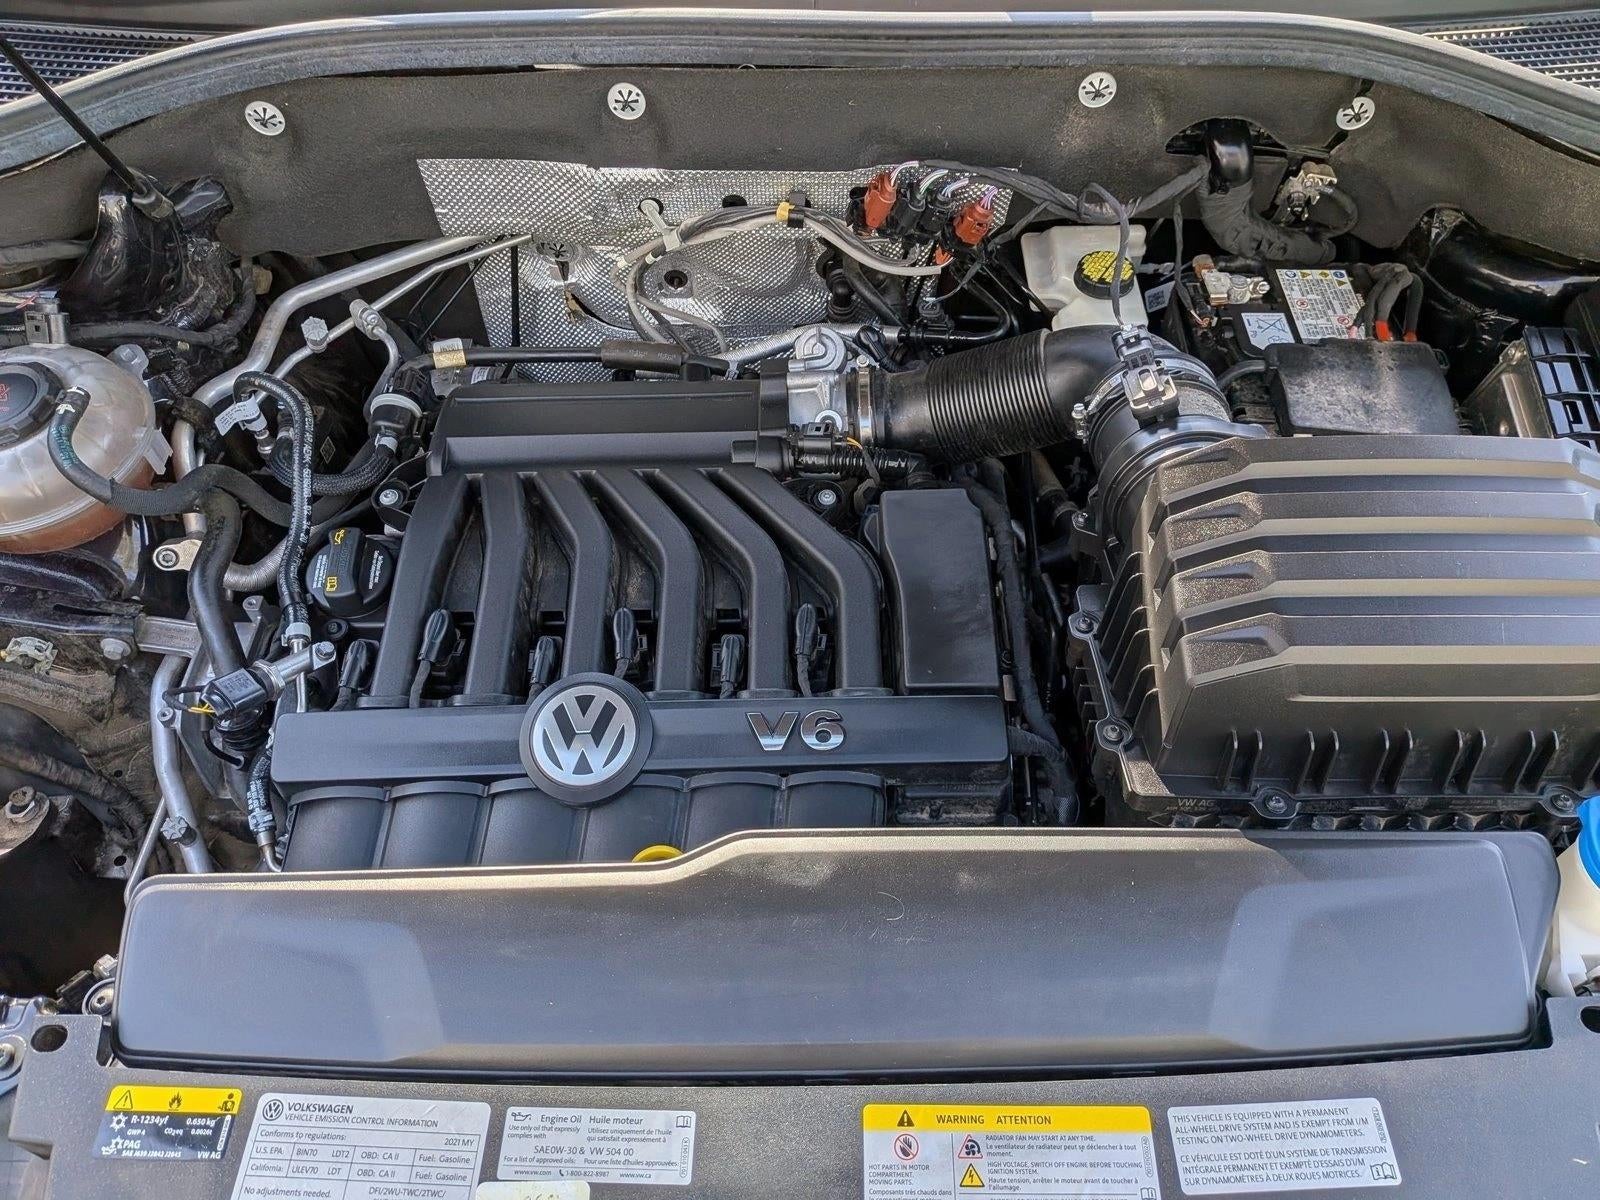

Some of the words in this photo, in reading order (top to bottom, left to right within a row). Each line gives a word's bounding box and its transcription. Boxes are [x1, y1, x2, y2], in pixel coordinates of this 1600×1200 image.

[745, 709, 846, 751] V6
[533, 685, 636, 786] VW
[1177, 798, 1197, 807] VW
[1198, 799, 1216, 807] AG
[288, 1102, 354, 1114] VOLKSWAGEN
[130, 1115, 169, 1125] R-1234yf
[541, 1114, 568, 1125] Engine
[570, 1115, 581, 1123] Oil
[589, 1116, 610, 1124] Huile
[612, 1116, 643, 1125] moteur
[936, 1114, 984, 1124] WARNING
[996, 1115, 1052, 1125] ATTENTION
[1173, 1115, 1190, 1123] THIS
[1191, 1114, 1223, 1122] VEHICLE
[1234, 1112, 1271, 1121] EQUIPPED
[1272, 1110, 1294, 1118] WITH
[1296, 1110, 1301, 1118] A
[1302, 1108, 1348, 1117] PERMANENT
[206, 1118, 216, 1127] kg
[315, 1115, 350, 1123] EMISSION
[351, 1116, 384, 1125] CONTROL
[386, 1118, 438, 1127] INFORMATION
[1175, 1125, 1218, 1134] ALL-WHEEL
[1219, 1124, 1241, 1132] DRIVE
[1243, 1122, 1272, 1131] SYSTEM
[1274, 1121, 1291, 1129] AND
[1301, 1119, 1331, 1128] EXEMPT
[1332, 1118, 1354, 1126] FROM
[1355, 1117, 1369, 1125] I/M
[260, 1129, 294, 1138] Conforms
[305, 1132, 346, 1141] regulations:
[554, 1126, 580, 1134] expressly
[1177, 1136, 1208, 1145] TESTING
[1224, 1133, 1273, 1142] TWO-WHEEL
[1274, 1132, 1298, 1140] DRIVE
[1299, 1128, 1365, 1139] DYNAMOMETERS.
[123, 1140, 141, 1149] PAG
[255, 1146, 268, 1154] U.S.
[296, 1148, 317, 1157] BIN70
[332, 1150, 350, 1158] LDT2
[578, 1146, 585, 1154] &
[590, 1147, 604, 1155] VW
[606, 1148, 621, 1156] 504
[623, 1148, 634, 1156] 00
[1180, 1155, 1190, 1163] CE
[1190, 1153, 1228, 1162] VÉHICULE
[1230, 1153, 1242, 1161] EST
[1243, 1150, 1263, 1160] DOTÉ
[1265, 1150, 1285, 1159] D'UN
[1287, 1148, 1319, 1158] SYSTÈME
[1320, 1148, 1330, 1156] DE
[1331, 1146, 1387, 1156] TRANSMISSION
[361, 1151, 379, 1159] OBD:
[382, 1152, 392, 1160] CA
[419, 1154, 436, 1162] Fuel:
[440, 1154, 470, 1163] Gasoline
[251, 1163, 283, 1172] California:
[291, 1165, 318, 1174] ULEV70
[327, 1166, 341, 1174] LDT
[1182, 1164, 1222, 1174] INTÉGRALE
[1223, 1162, 1268, 1172] PERMANENT
[1270, 1162, 1278, 1170] ET
[1280, 1159, 1312, 1170] EXEMPTÉ
[1313, 1159, 1344, 1168] D'ESSAIS
[357, 1169, 375, 1177] OBD:
[415, 1172, 432, 1180] Fuel:
[436, 1172, 467, 1181] Gasoline
[1184, 1177, 1201, 1185] SUR
[1202, 1174, 1264, 1185] DYNAMOMÈTRES
[1266, 1172, 1271, 1181] À
[1272, 1172, 1294, 1181] DEUX
[1296, 1172, 1320, 1180] ROUES
[1322, 1170, 1362, 1179] MOTRICES.
[244, 1186, 254, 1195] No
[256, 1187, 300, 1197] adjustments
[301, 1189, 331, 1198] needed.
[868, 1188, 904, 1196] Composants
